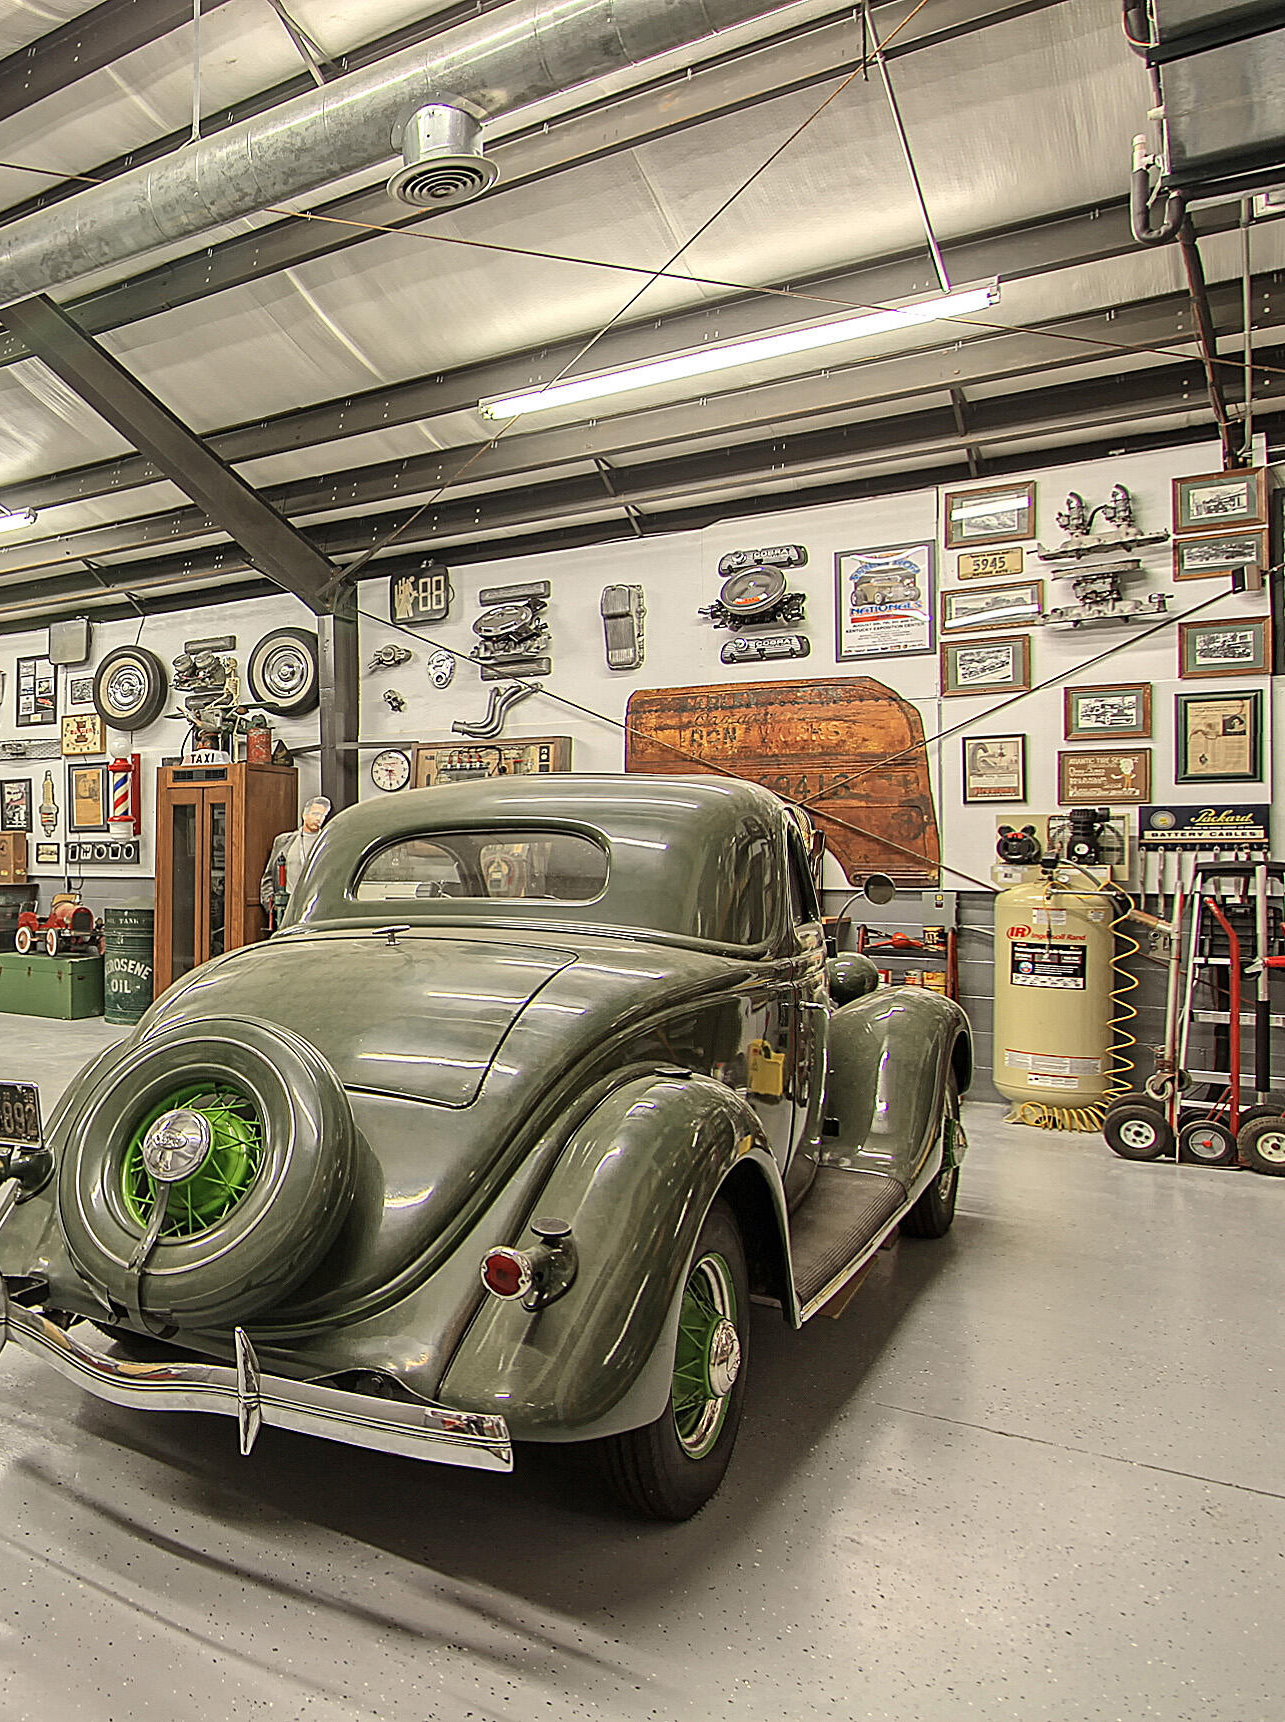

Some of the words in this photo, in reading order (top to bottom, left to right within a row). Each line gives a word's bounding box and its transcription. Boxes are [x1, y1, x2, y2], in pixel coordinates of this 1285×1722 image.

[972, 556, 1007, 573] 5945
[850, 601, 923, 616] NATIONALS
[190, 753, 215, 764] TAXI
[1189, 808, 1255, 825] Packard
[1010, 926, 1027, 938] IR
[111, 978, 132, 994] OIL
